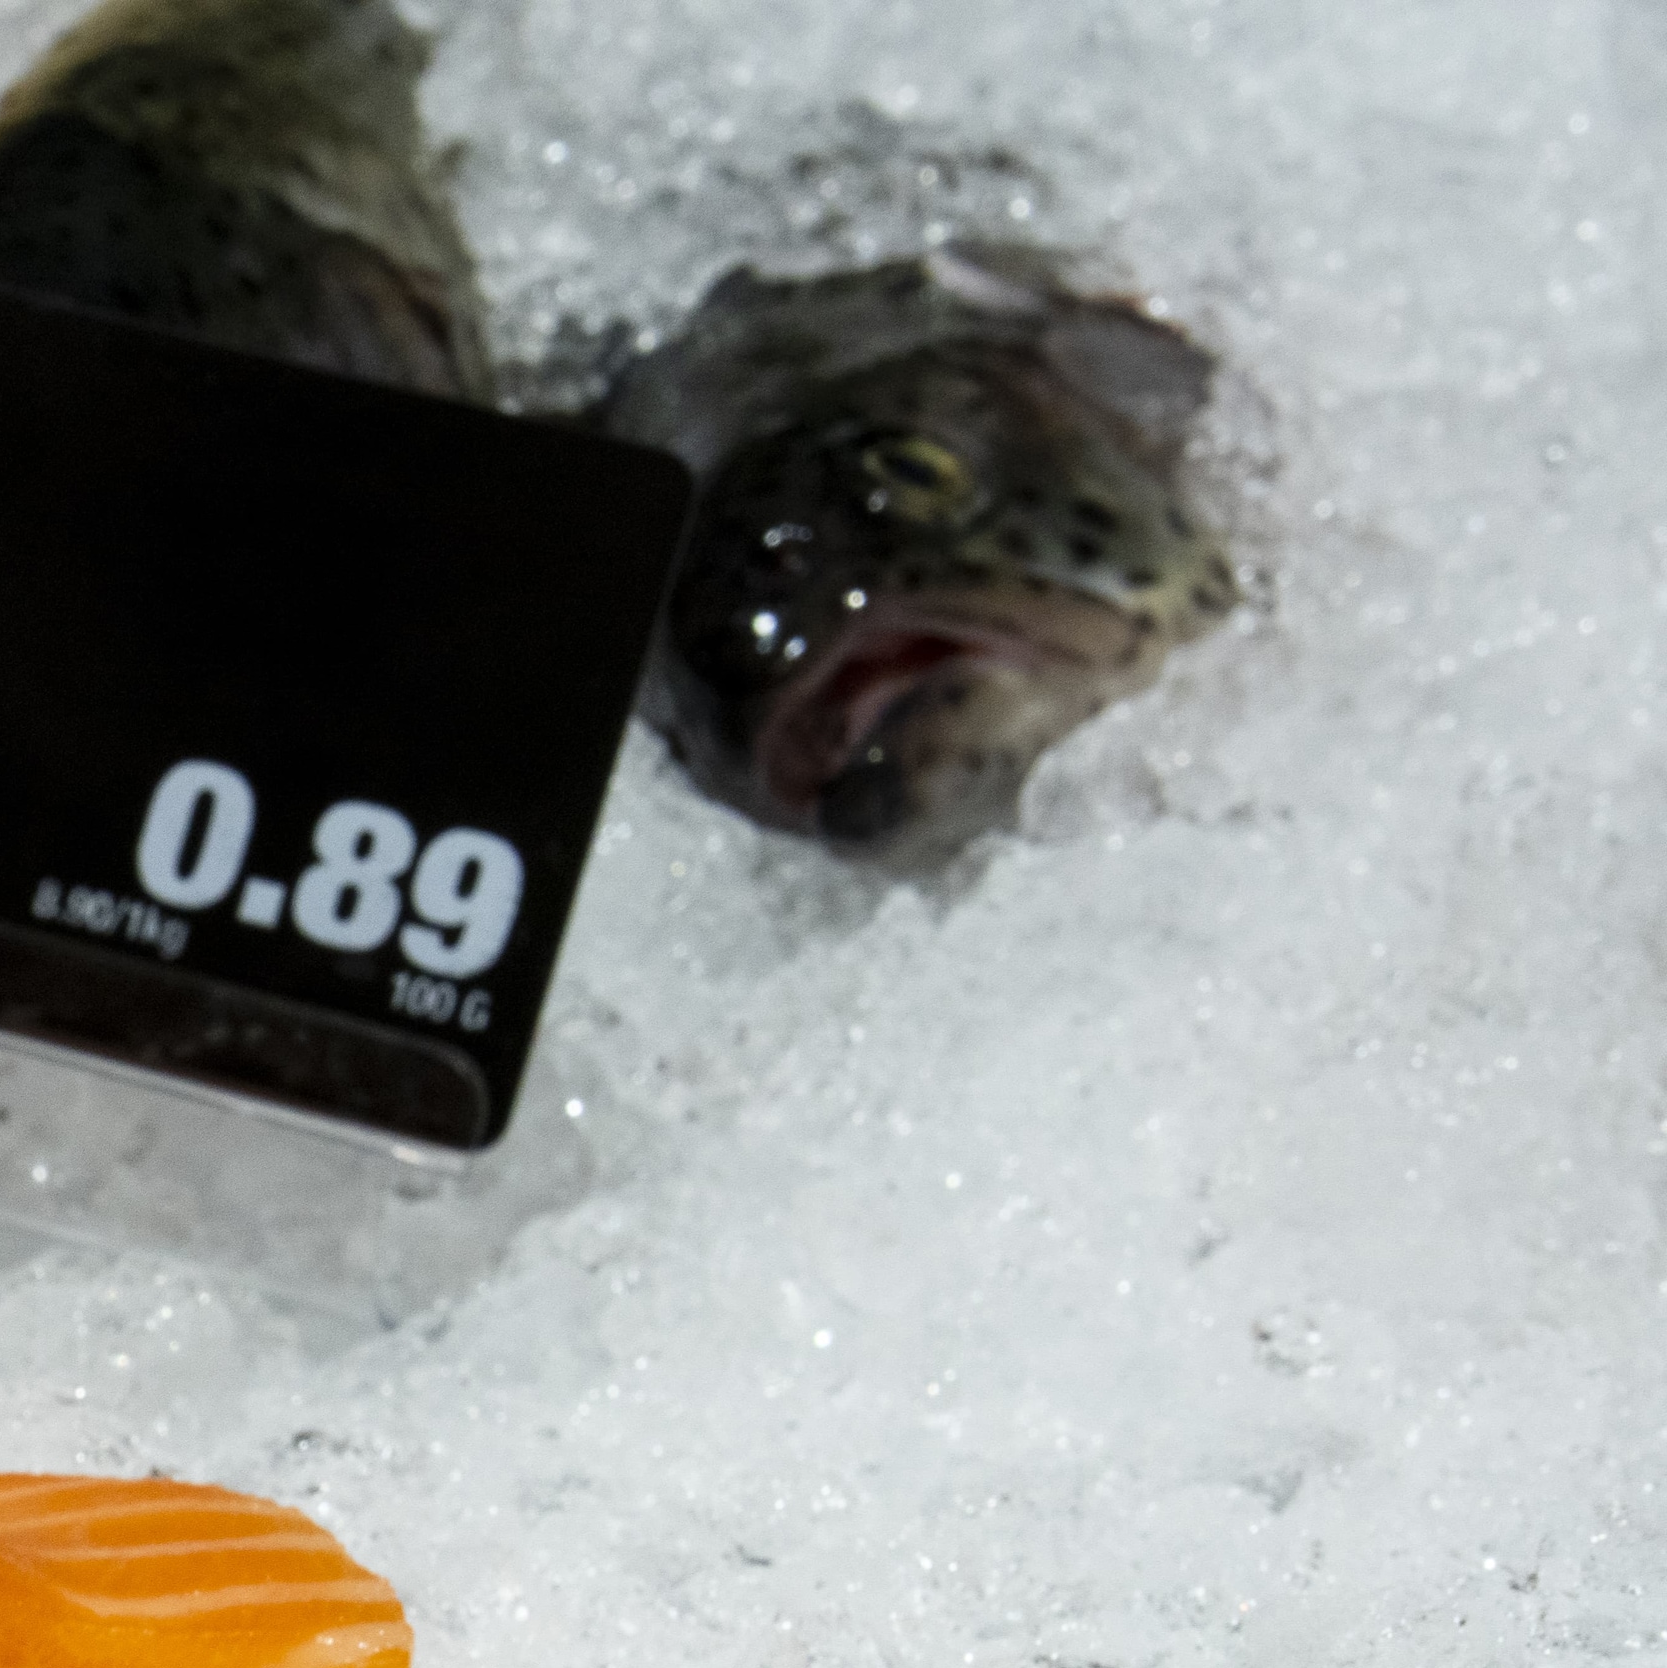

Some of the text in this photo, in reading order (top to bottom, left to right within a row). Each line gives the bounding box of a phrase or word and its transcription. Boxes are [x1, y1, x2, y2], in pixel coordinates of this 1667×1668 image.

[135, 758, 525, 980] 0.89
[391, 972, 491, 1031] 100 G
